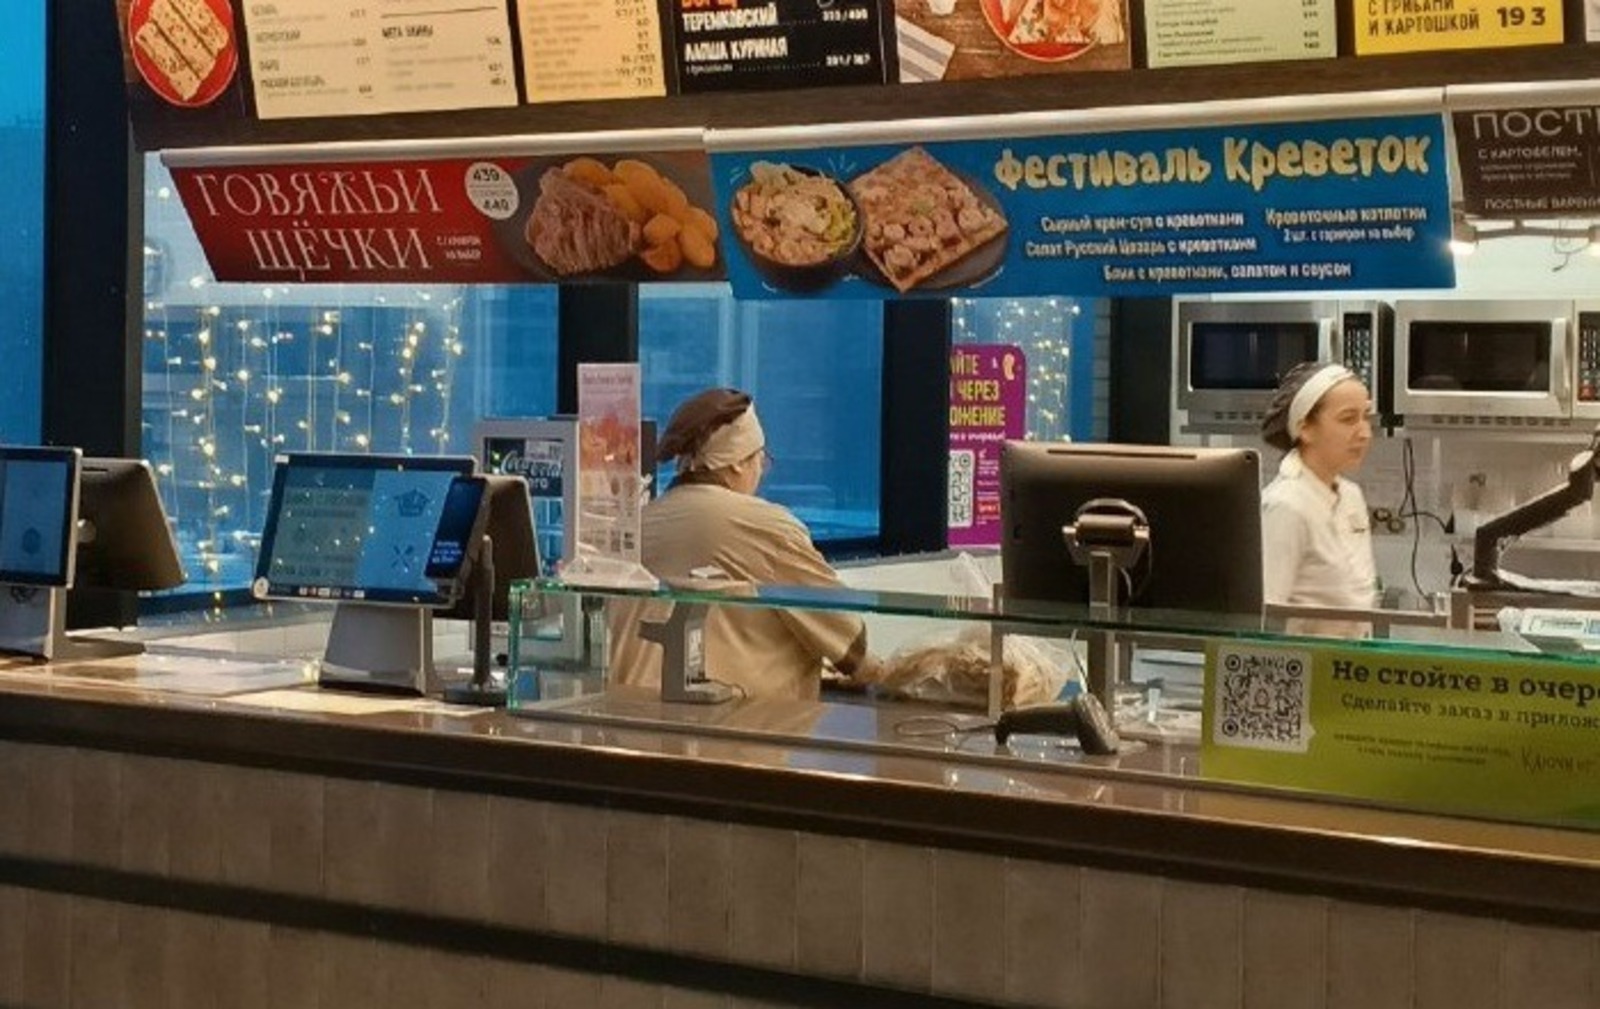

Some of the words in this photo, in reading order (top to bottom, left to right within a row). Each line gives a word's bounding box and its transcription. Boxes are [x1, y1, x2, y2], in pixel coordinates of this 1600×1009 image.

[682, 2, 779, 32] ТЕРЕМКОВСКИЙ
[1368, 20, 1379, 36] И
[1385, 9, 1480, 36] КАРТОШКОЙ
[730, 36, 788, 60] КУРИНАЯ
[1474, 107, 1600, 140] ПОСТ
[193, 168, 442, 216] ГОВЯЖЬИ
[247, 219, 431, 282] ЩЁЧКИ
[956, 379, 1000, 401] ЧЕРЕЗ
[1332, 661, 1369, 683] Не
[1377, 666, 1482, 692] стойте
[1491, 676, 1509, 694] в
[1519, 677, 1600, 707] очер
[1341, 693, 1432, 716] Сделайте
[1437, 703, 1493, 721] заказ
